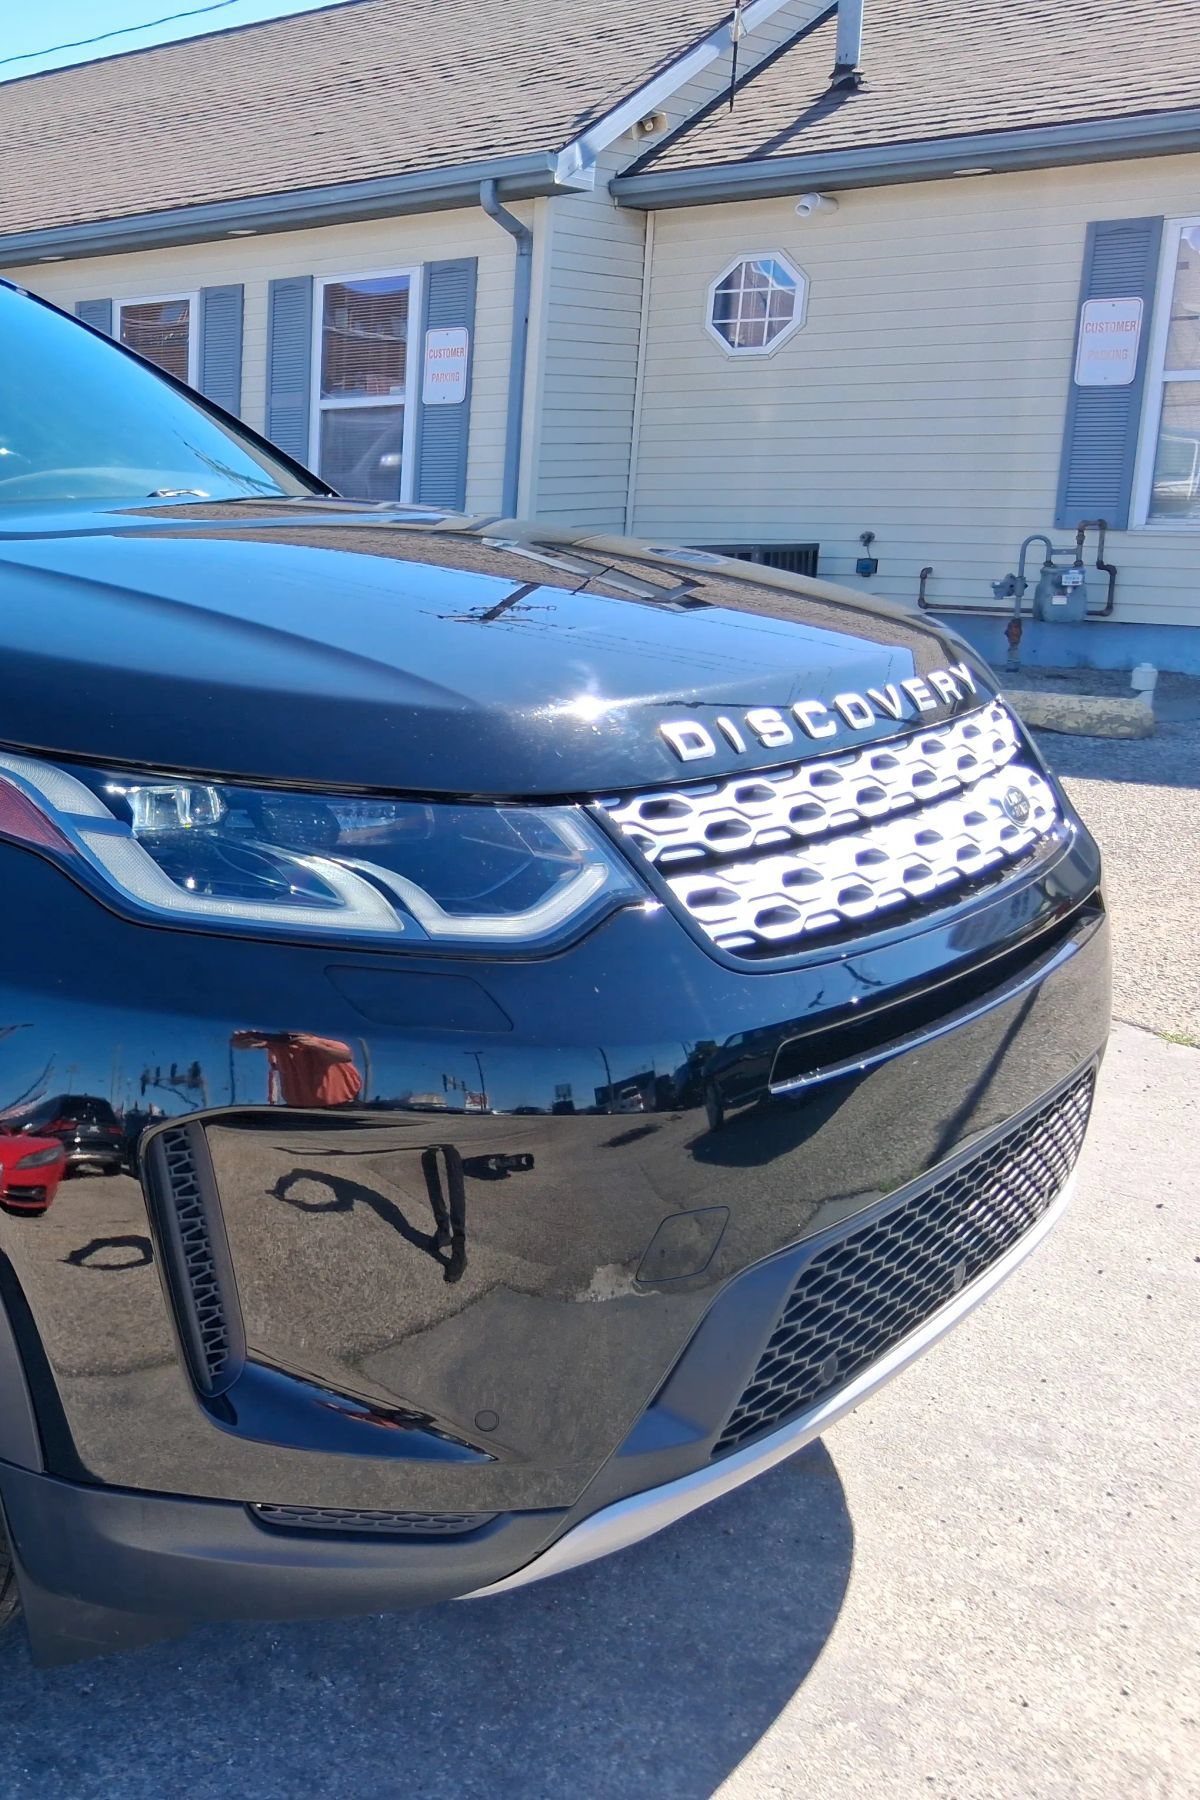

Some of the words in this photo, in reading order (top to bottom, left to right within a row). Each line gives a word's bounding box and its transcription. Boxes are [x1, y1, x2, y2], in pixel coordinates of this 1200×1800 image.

[1084, 320, 1137, 333] CUSTOMER
[428, 347, 465, 359] CUSTOMER
[431, 371, 460, 384] PARKING
[658, 662, 978, 762] DISCOVERY
